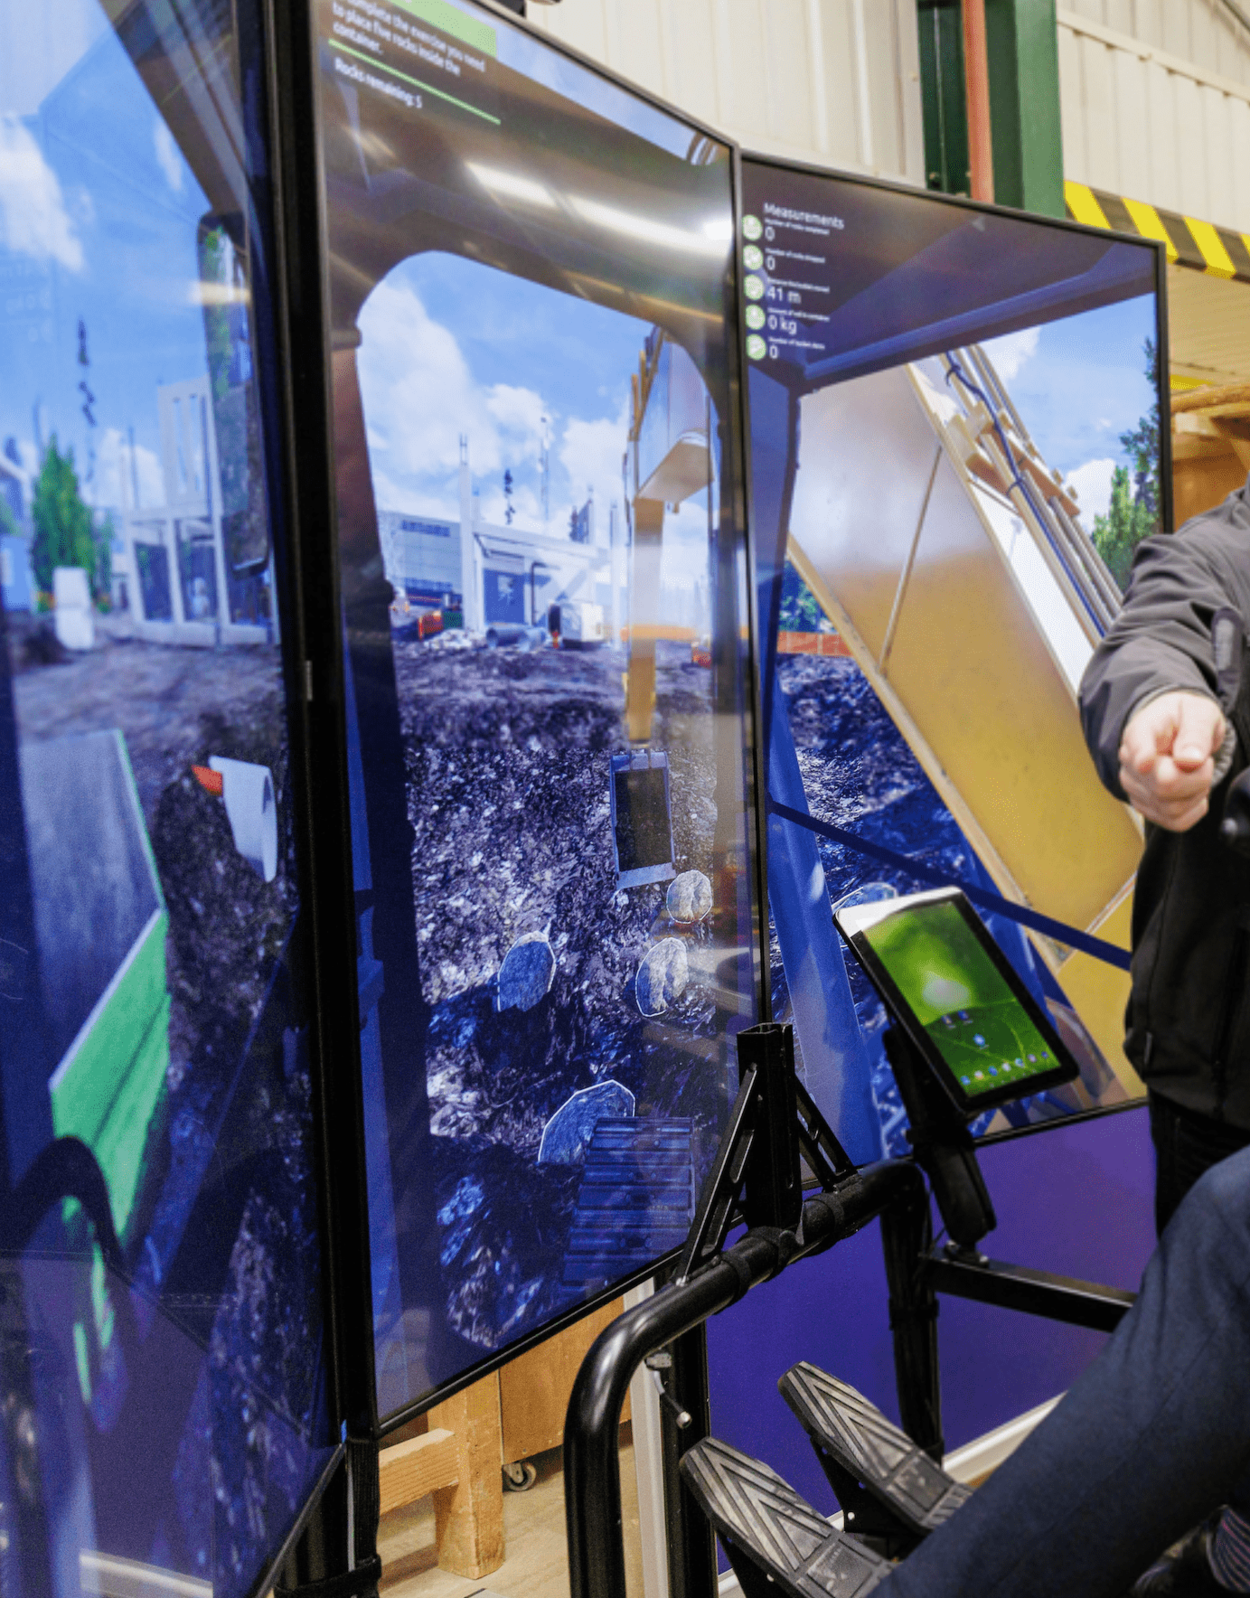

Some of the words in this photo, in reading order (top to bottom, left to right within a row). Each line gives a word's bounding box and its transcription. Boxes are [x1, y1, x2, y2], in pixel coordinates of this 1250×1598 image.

[335, 56, 366, 82] Rocks
[763, 202, 845, 230] Measurements
[767, 287, 783, 301] 41
[787, 290, 801, 304] m
[767, 315, 778, 330] 0
[780, 316, 797, 335] kg
[769, 344, 779, 359] 0
